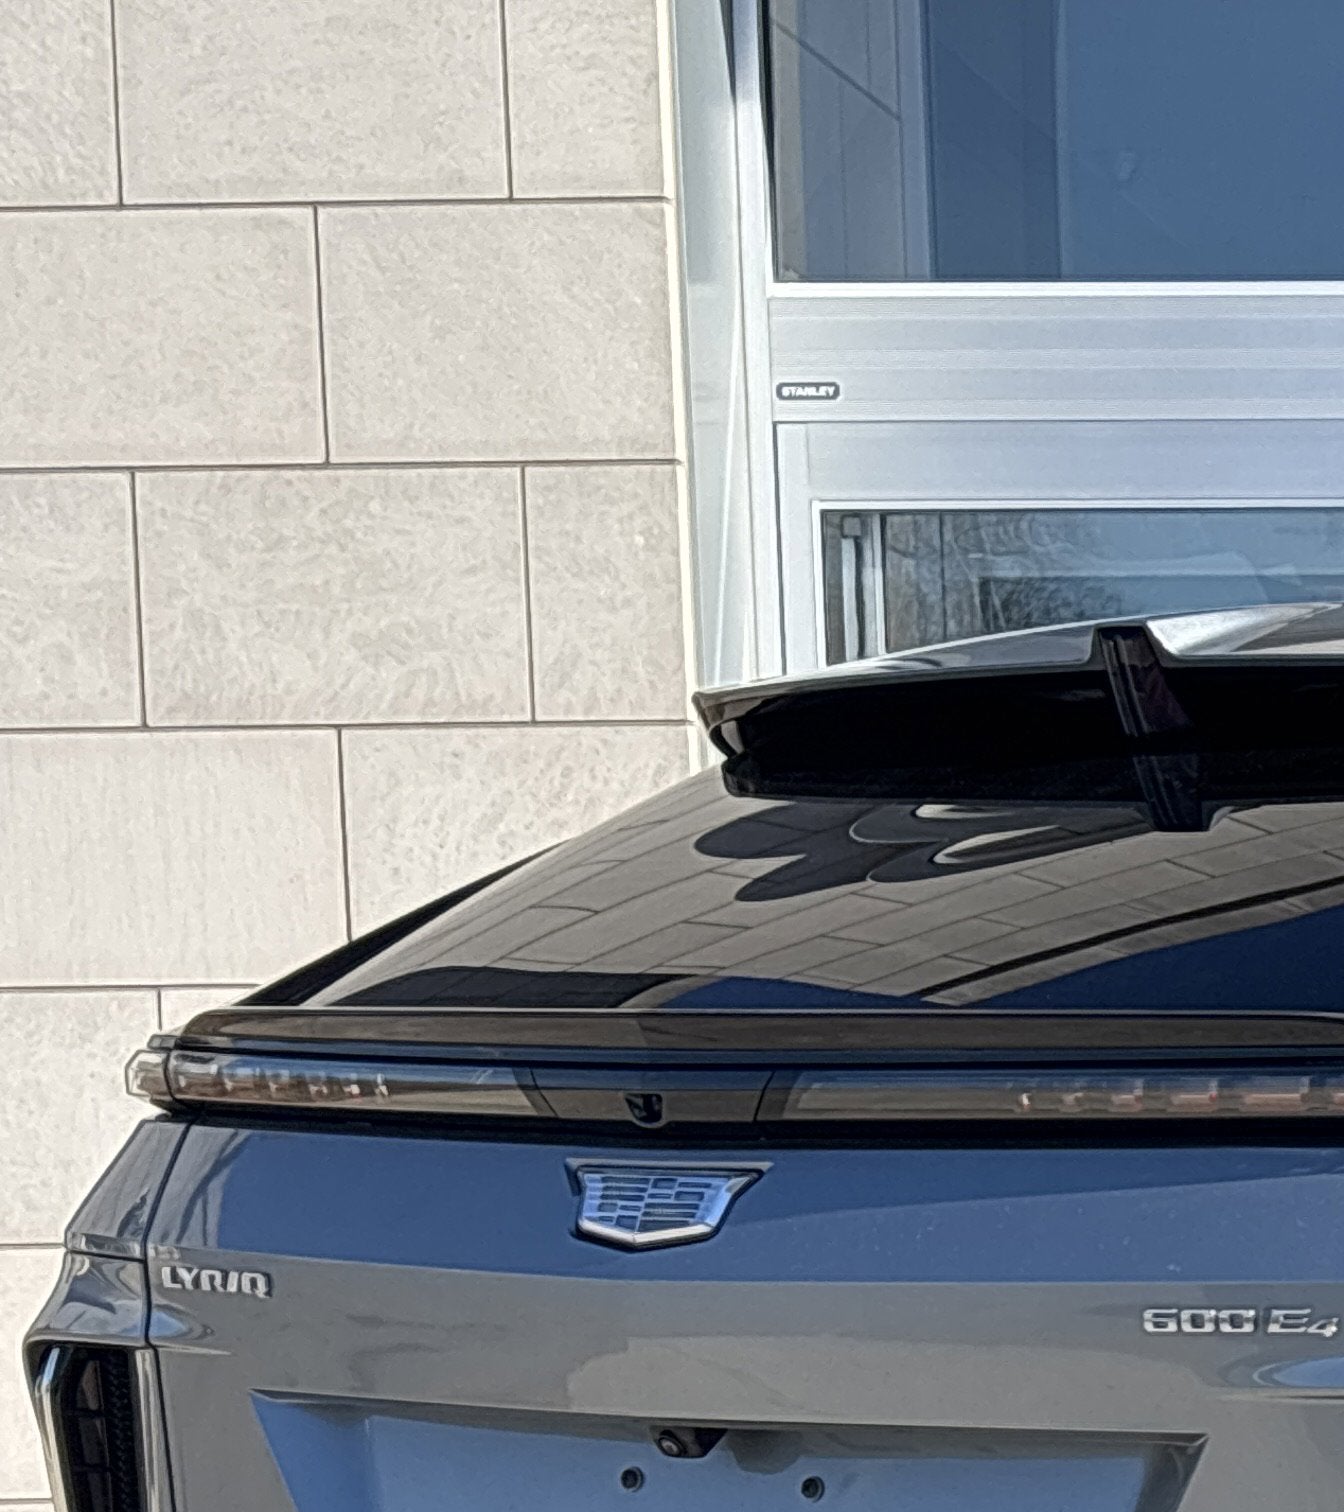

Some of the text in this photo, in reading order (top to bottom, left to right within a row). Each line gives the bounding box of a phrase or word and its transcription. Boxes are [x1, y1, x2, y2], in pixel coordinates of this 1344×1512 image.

[781, 386, 835, 397] STANLEY
[161, 1266, 272, 1299] LYRIQ
[1143, 1308, 1256, 1333] 600
